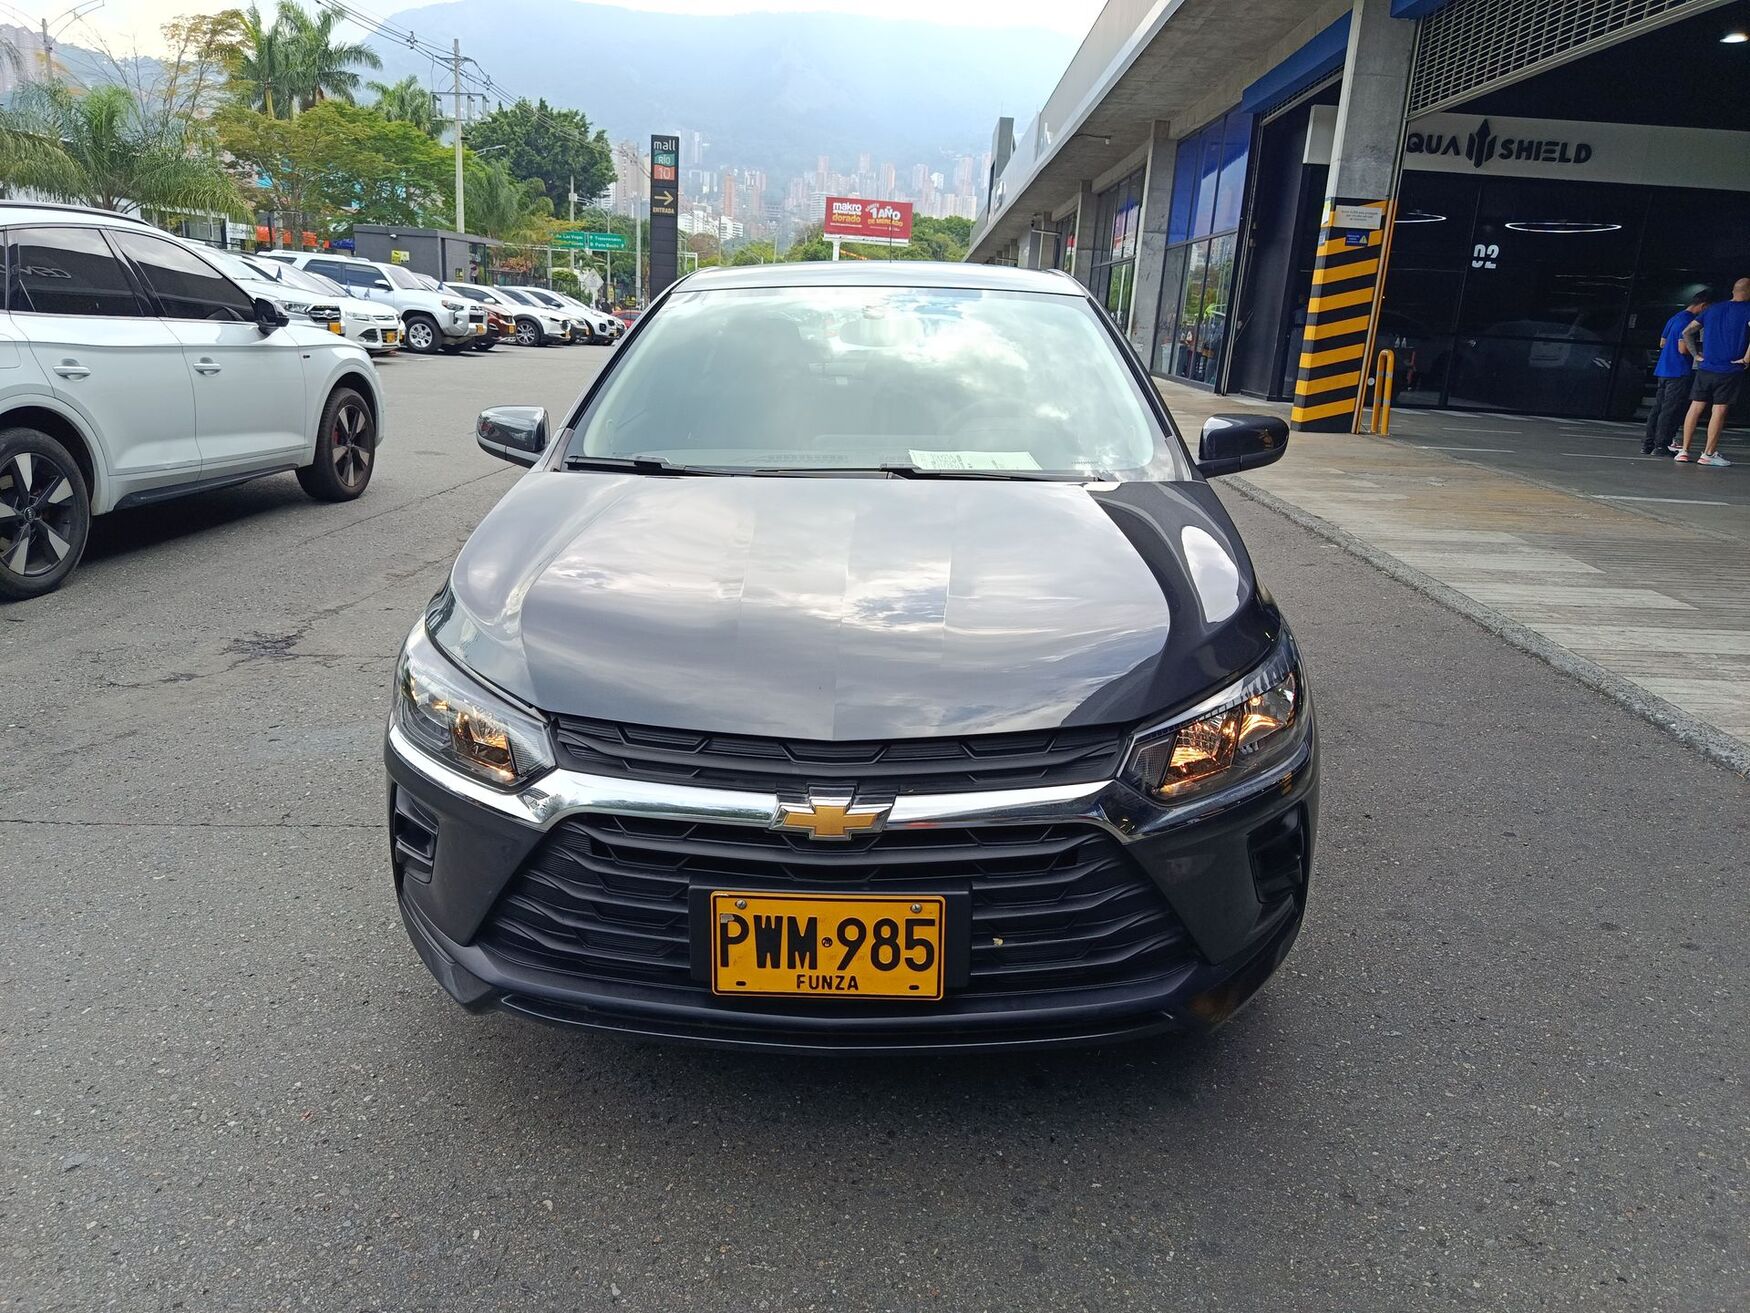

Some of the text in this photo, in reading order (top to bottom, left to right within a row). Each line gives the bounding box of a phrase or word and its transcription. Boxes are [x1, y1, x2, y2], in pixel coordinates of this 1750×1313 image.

[653, 139, 676, 151] mall
[1498, 138, 1593, 164] SHIELD
[658, 167, 671, 180] 10
[832, 202, 862, 212] makro
[870, 207, 877, 219] 1
[878, 206, 901, 220] AÑO
[832, 213, 861, 223] dorado
[1471, 244, 1499, 269] 02
[796, 974, 859, 991] FUNZA
